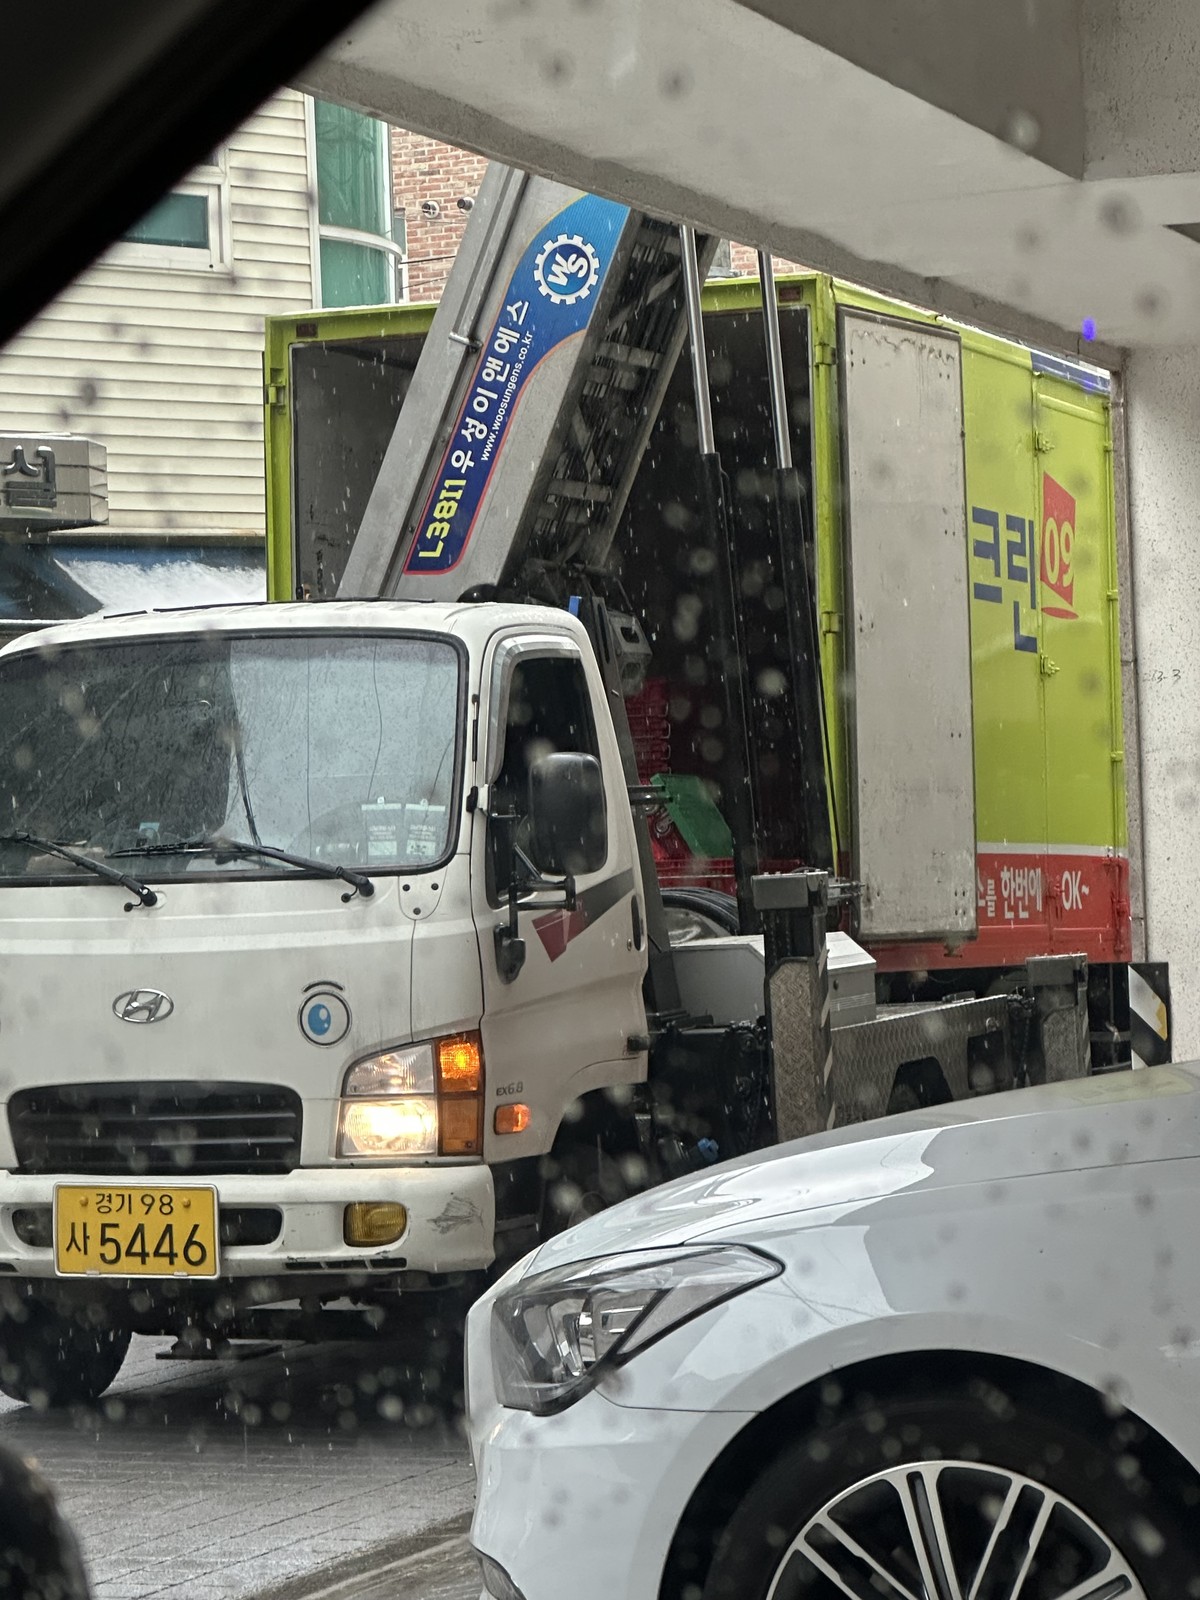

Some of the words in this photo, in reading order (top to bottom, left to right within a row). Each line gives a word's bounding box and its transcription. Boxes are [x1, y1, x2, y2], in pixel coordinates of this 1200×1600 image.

[547, 252, 589, 287] WS
[451, 300, 530, 475] 우성이앤에스
[481, 331, 533, 461] www.woosungens.co.kr
[972, 506, 1037, 653] 크린
[1045, 517, 1074, 587] 09
[1000, 866, 1043, 920] 한번에
